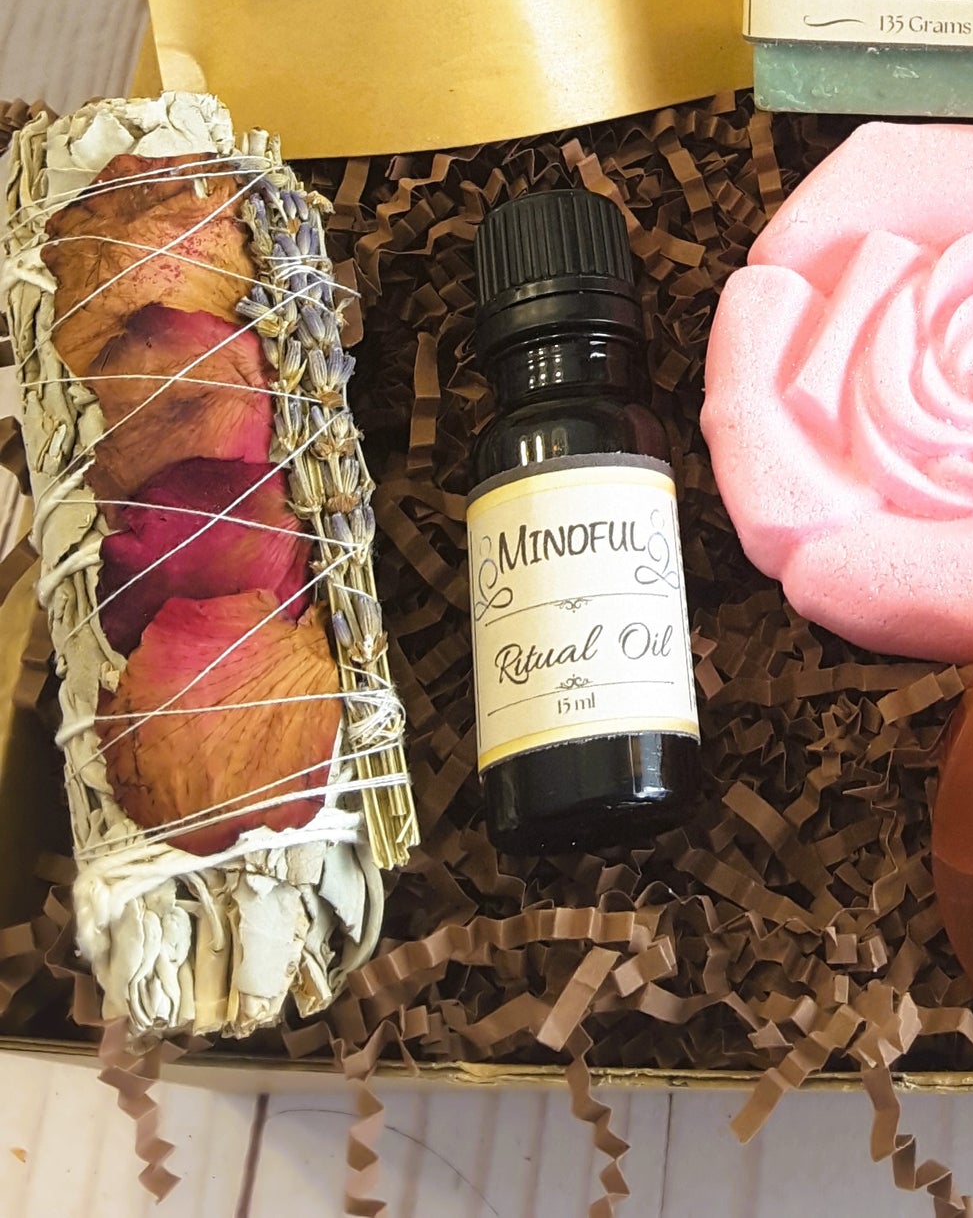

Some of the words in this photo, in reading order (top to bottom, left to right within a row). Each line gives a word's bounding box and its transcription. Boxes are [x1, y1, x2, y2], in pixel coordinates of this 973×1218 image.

[879, 16, 905, 33] 135
[909, 16, 972, 36] Grams
[498, 521, 646, 574] MINDFUL
[494, 624, 603, 684] Ritual
[618, 622, 673, 660] Oil
[557, 698, 571, 714] 15
[574, 693, 596, 711] ml
